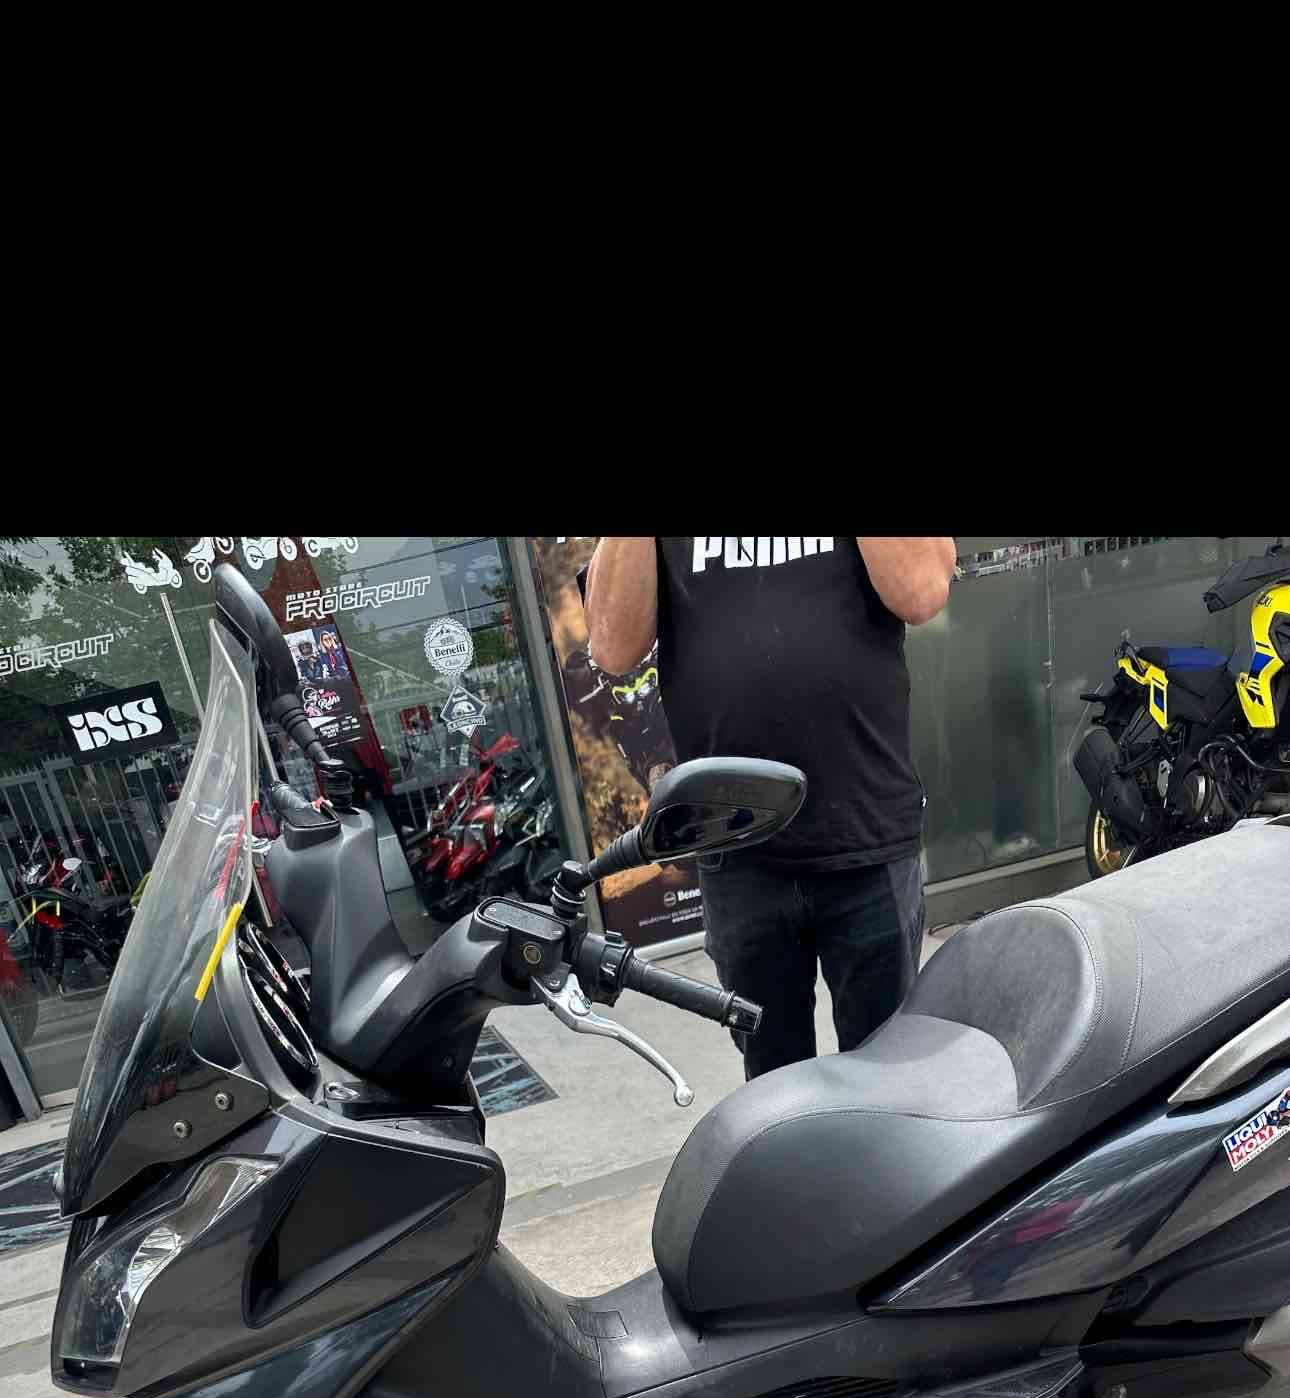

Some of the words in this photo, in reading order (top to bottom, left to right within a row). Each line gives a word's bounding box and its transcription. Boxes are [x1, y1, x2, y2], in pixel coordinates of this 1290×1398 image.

[286, 589, 321, 602] MOTO
[434, 643, 466, 657] Benelli
[1231, 1125, 1278, 1163] MOLY
